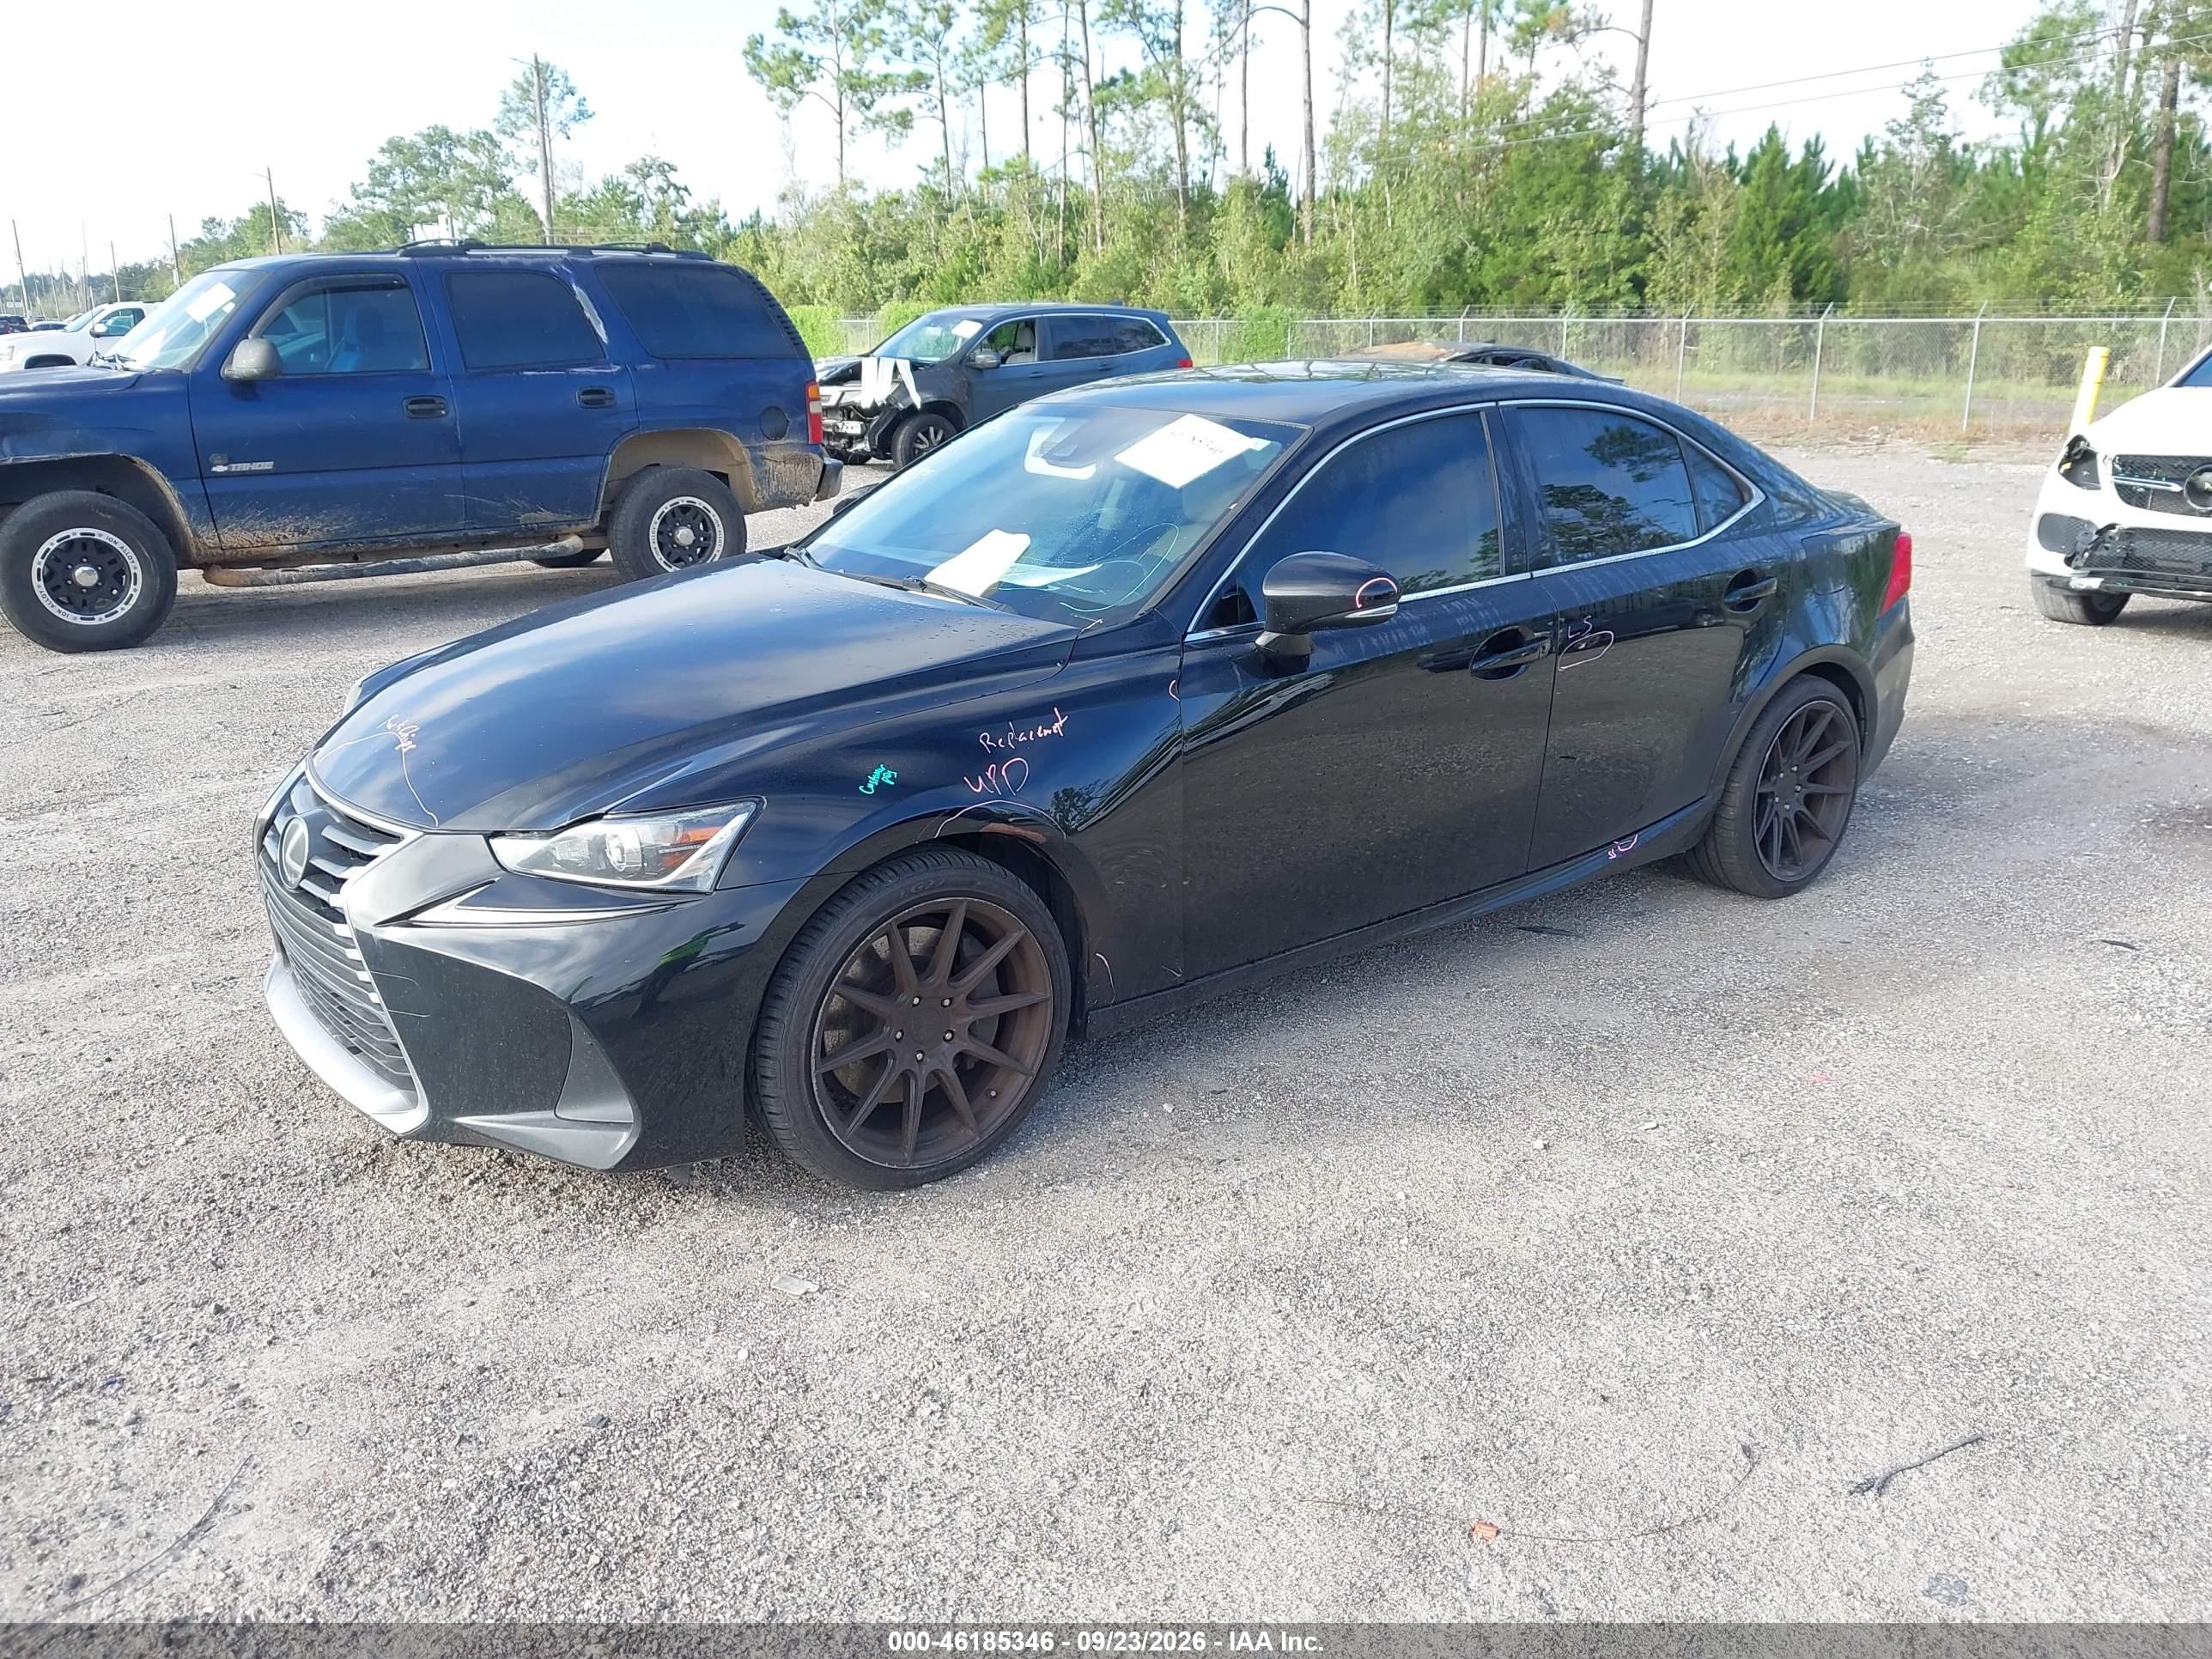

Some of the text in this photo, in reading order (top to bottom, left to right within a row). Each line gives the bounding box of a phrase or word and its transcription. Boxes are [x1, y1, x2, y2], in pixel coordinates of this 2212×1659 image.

[228, 461, 274, 471] TAHOE
[106, 535, 136, 563] ION ALLOY
[39, 590, 70, 618] ION ALLOY
